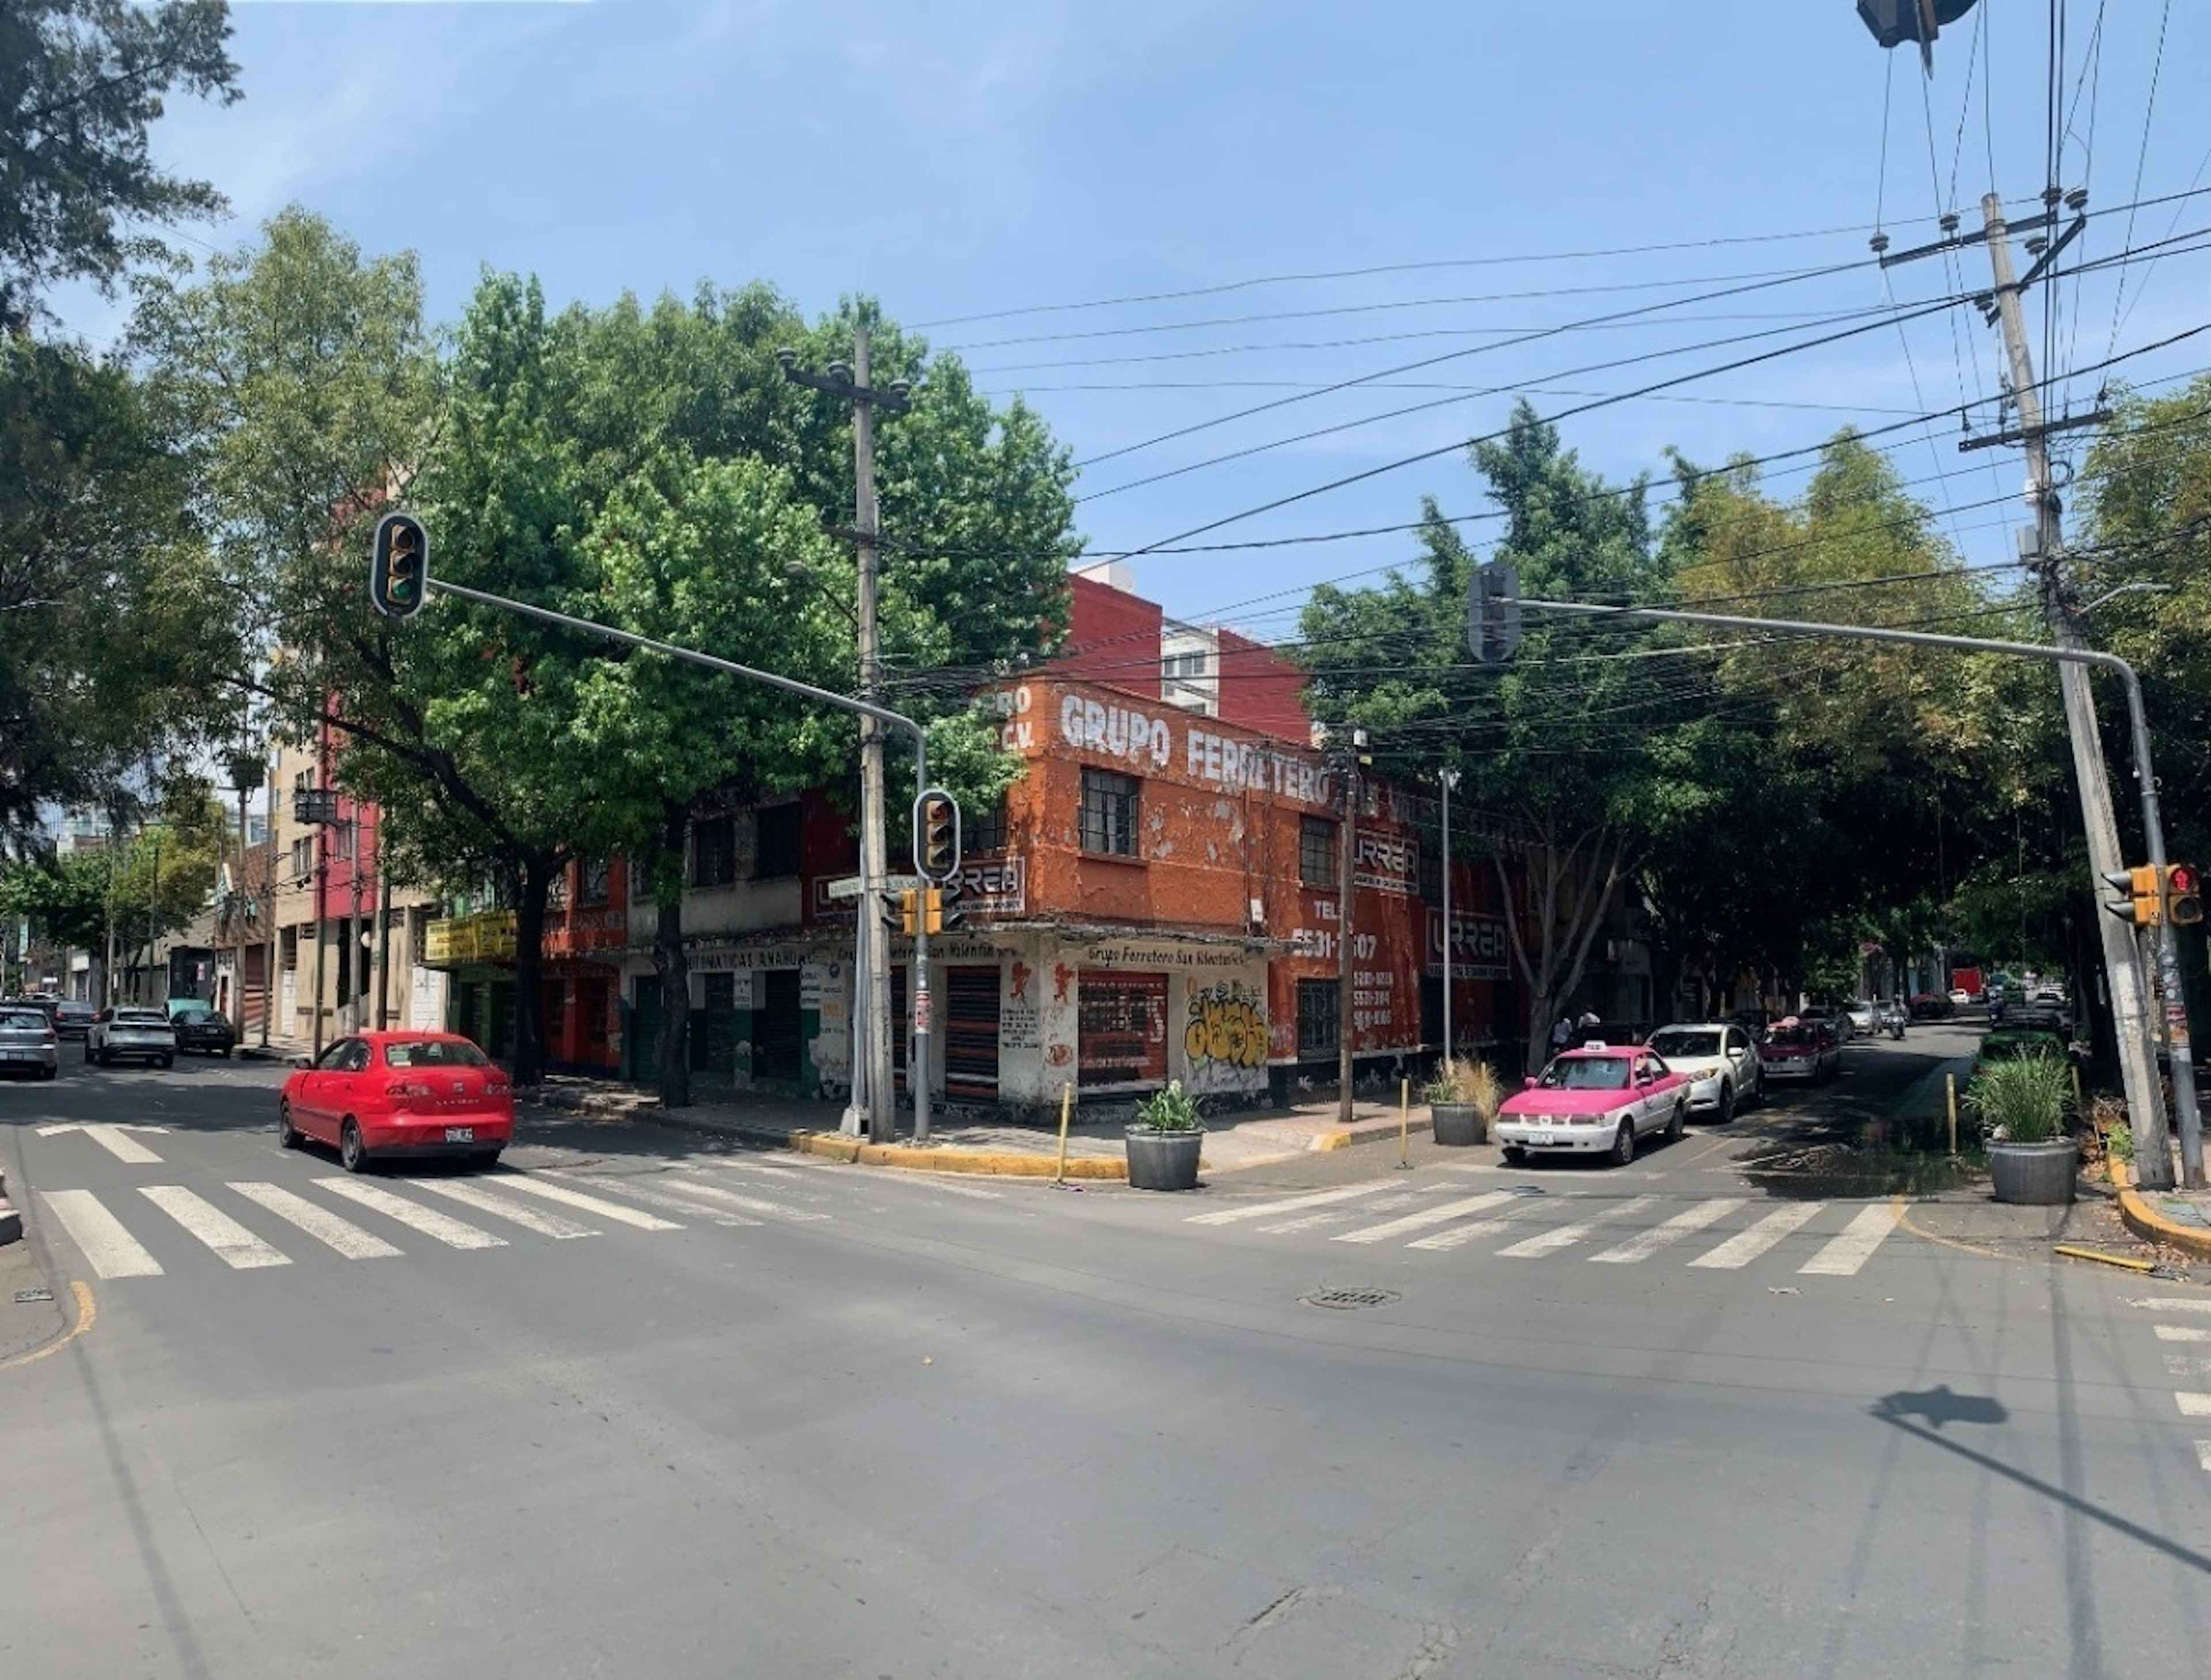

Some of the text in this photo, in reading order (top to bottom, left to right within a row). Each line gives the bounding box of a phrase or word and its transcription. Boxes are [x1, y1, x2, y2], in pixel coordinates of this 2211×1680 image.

[1061, 694, 1171, 769] GRUPO
[1187, 729, 1330, 805] FERRETERO
[943, 866, 1019, 894] RREA
[1122, 947, 1173, 964] Ferretero
[1291, 928, 1377, 960] 5531-07
